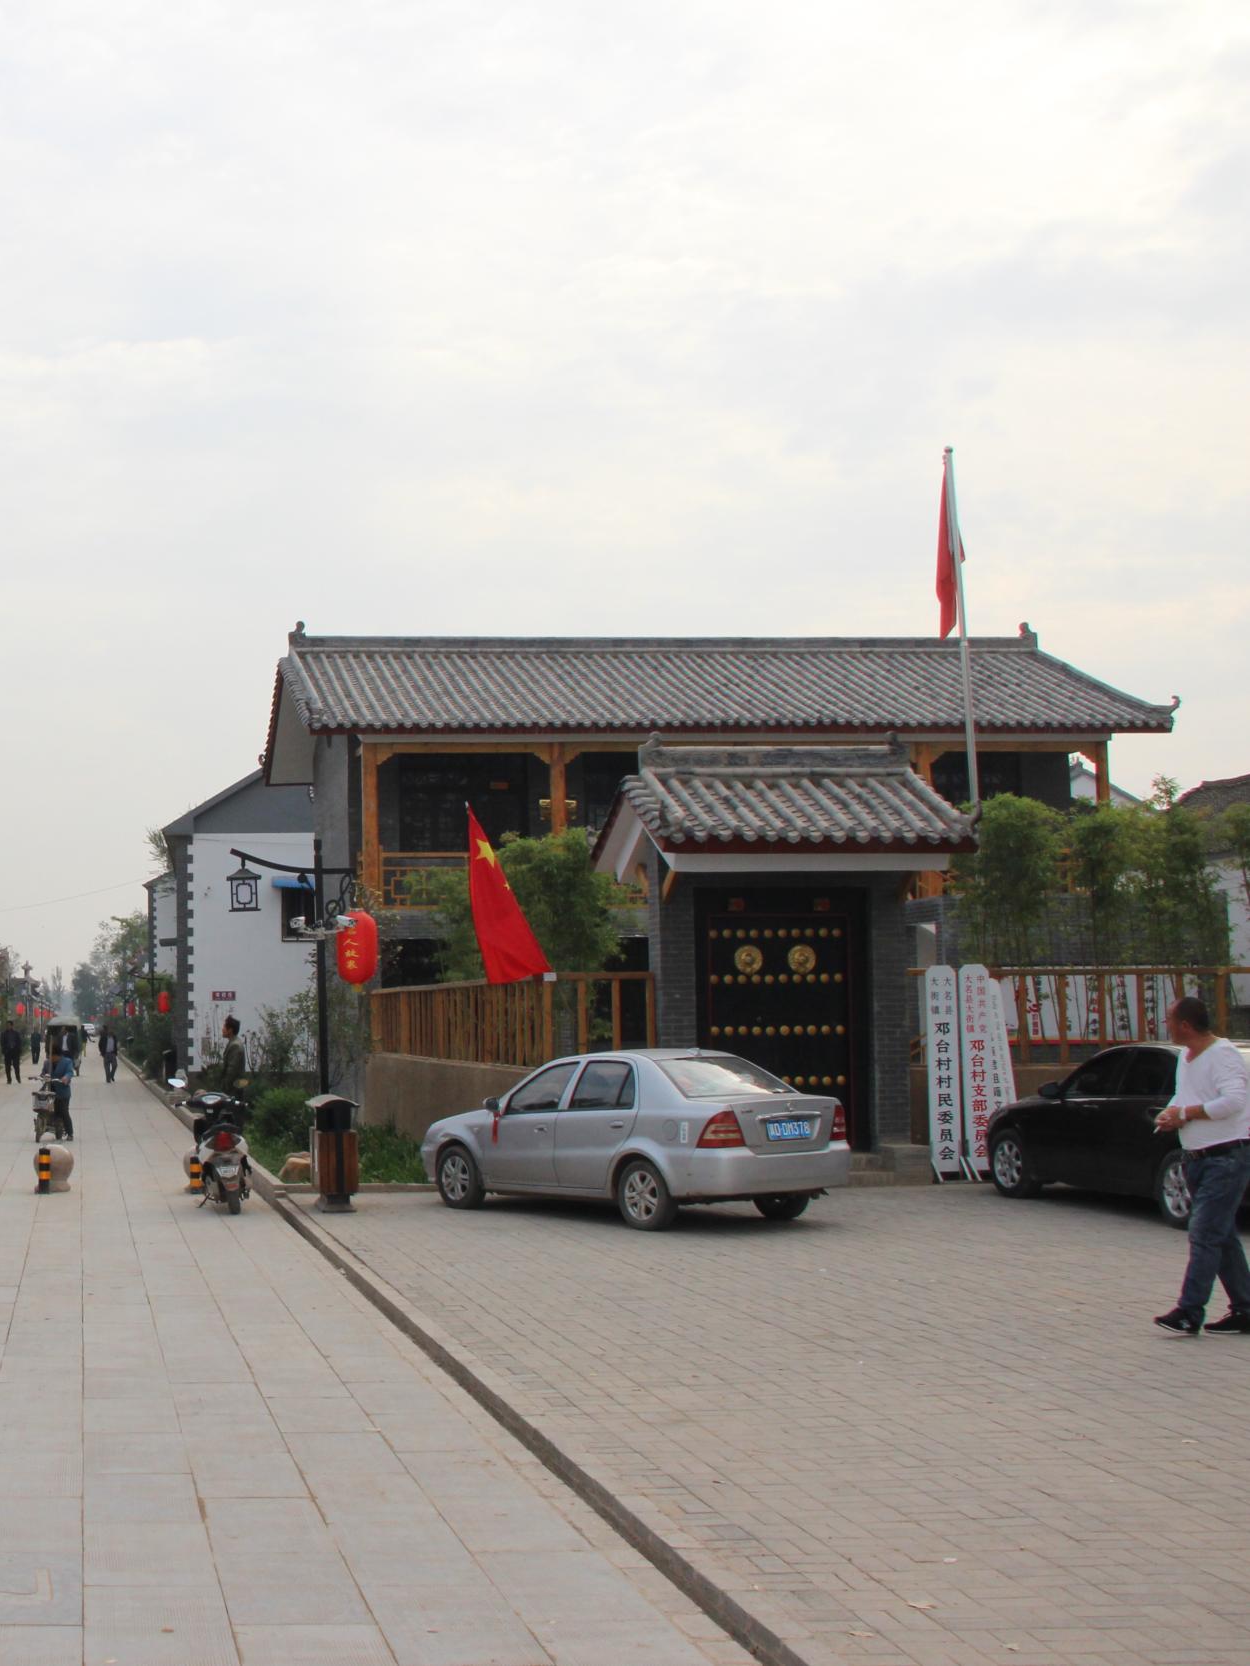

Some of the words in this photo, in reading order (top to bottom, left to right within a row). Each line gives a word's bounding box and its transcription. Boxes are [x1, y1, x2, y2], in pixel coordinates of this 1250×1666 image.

[934, 1021, 956, 1161] 邓台村村民委员会
[969, 1039, 990, 1159] 邓台村支部委员会
